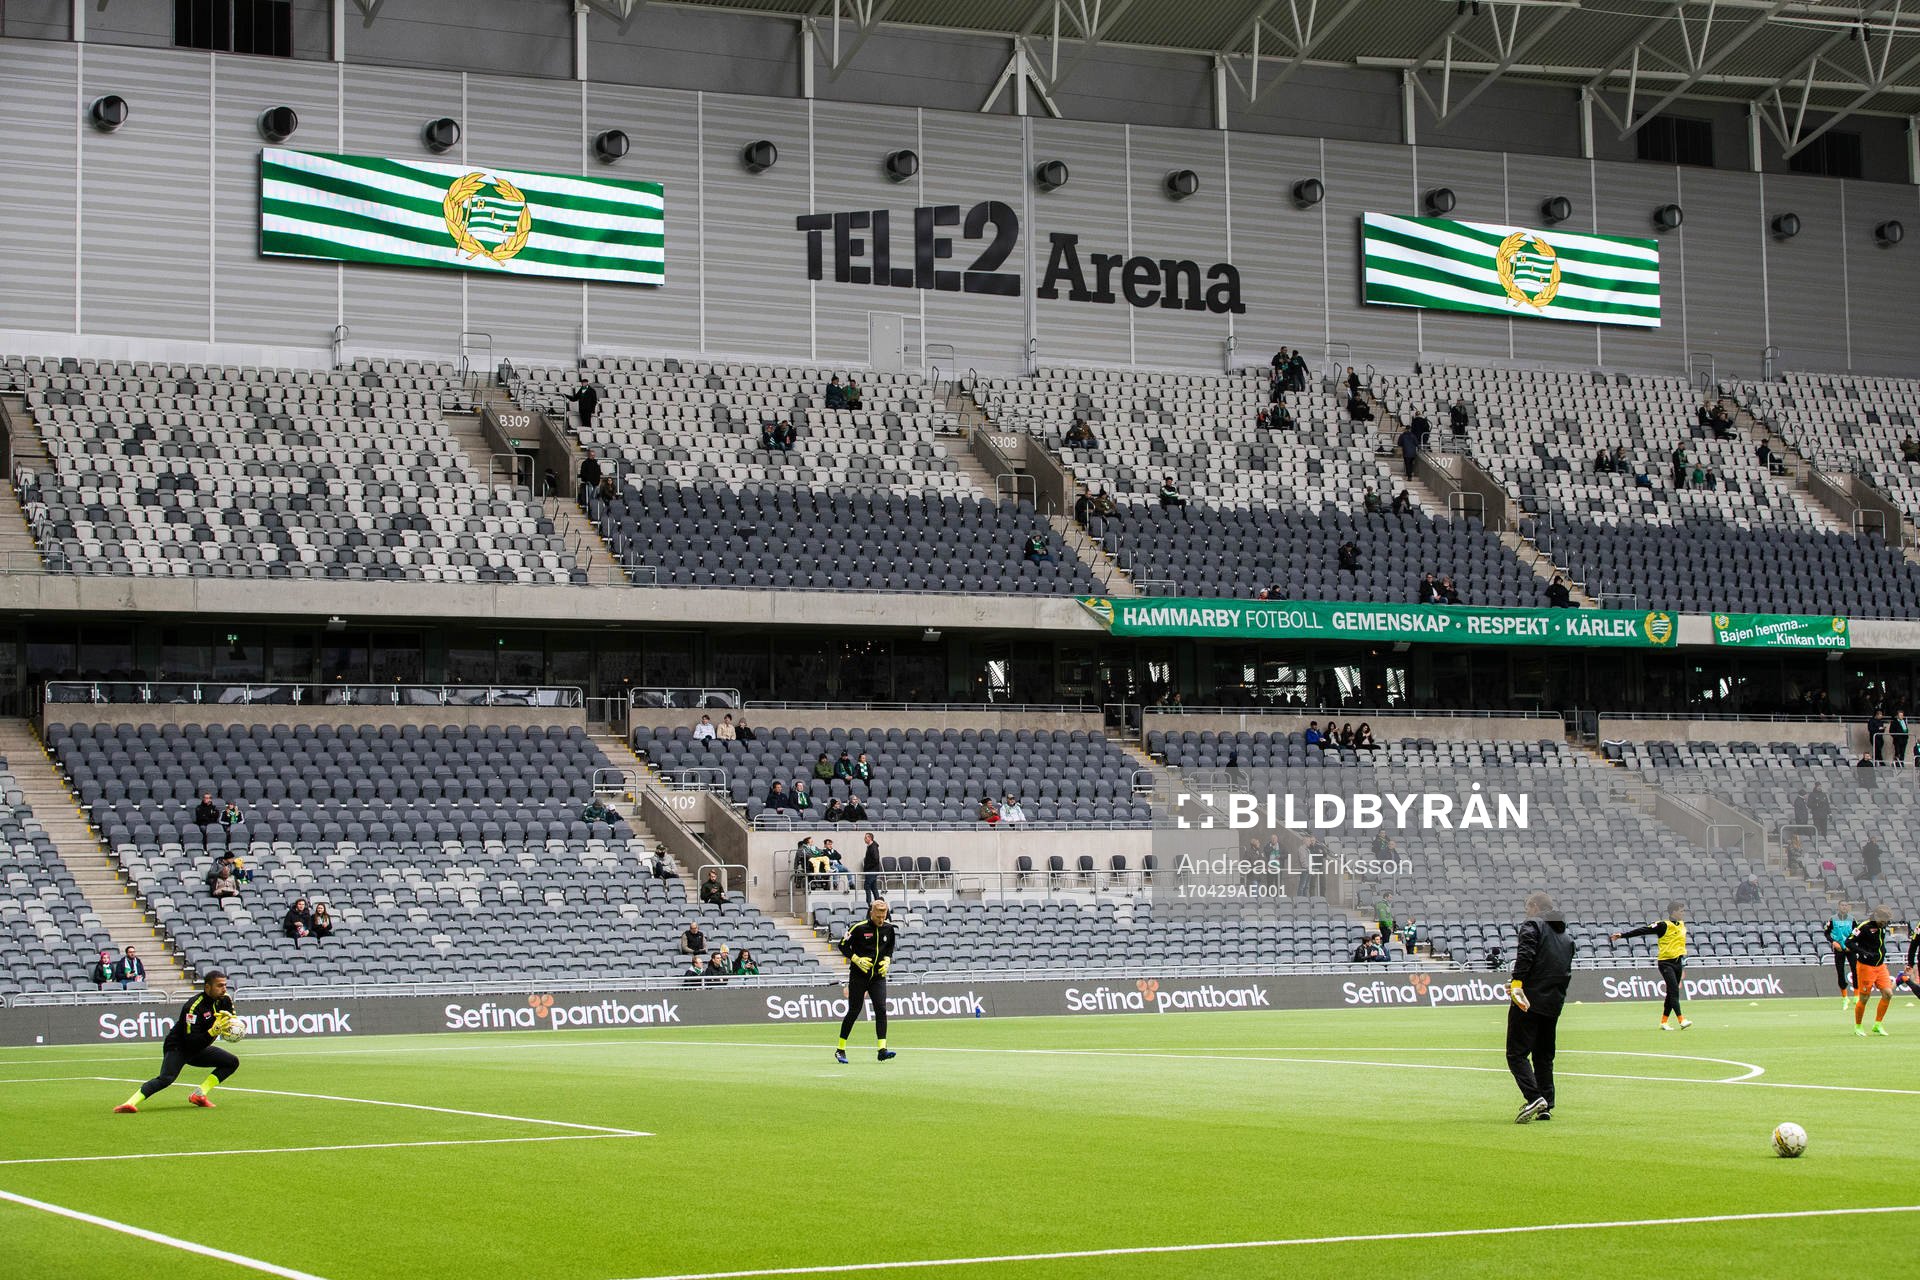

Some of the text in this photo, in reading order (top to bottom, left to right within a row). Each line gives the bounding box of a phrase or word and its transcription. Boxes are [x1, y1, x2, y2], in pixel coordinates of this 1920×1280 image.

[797, 201, 1246, 314] TELE2 Arena
[500, 415, 530, 427] B309
[1123, 607, 1637, 637] HAMMARBY FOTBOLL GEMENSKAP RESPEKT KÄRLEK
[1720, 628, 1753, 643] Bajen
[1817, 635, 1845, 646] borta
[1065, 984, 1270, 1014] Sefina pantbank
[1342, 979, 1511, 1008] Sefina pantba
[1603, 973, 1784, 1001] Sefina pantbank
[445, 999, 680, 1031] Sefina pantbank
[766, 994, 850, 1019] Sefina
[99, 1008, 352, 1039] Sefin antbank
